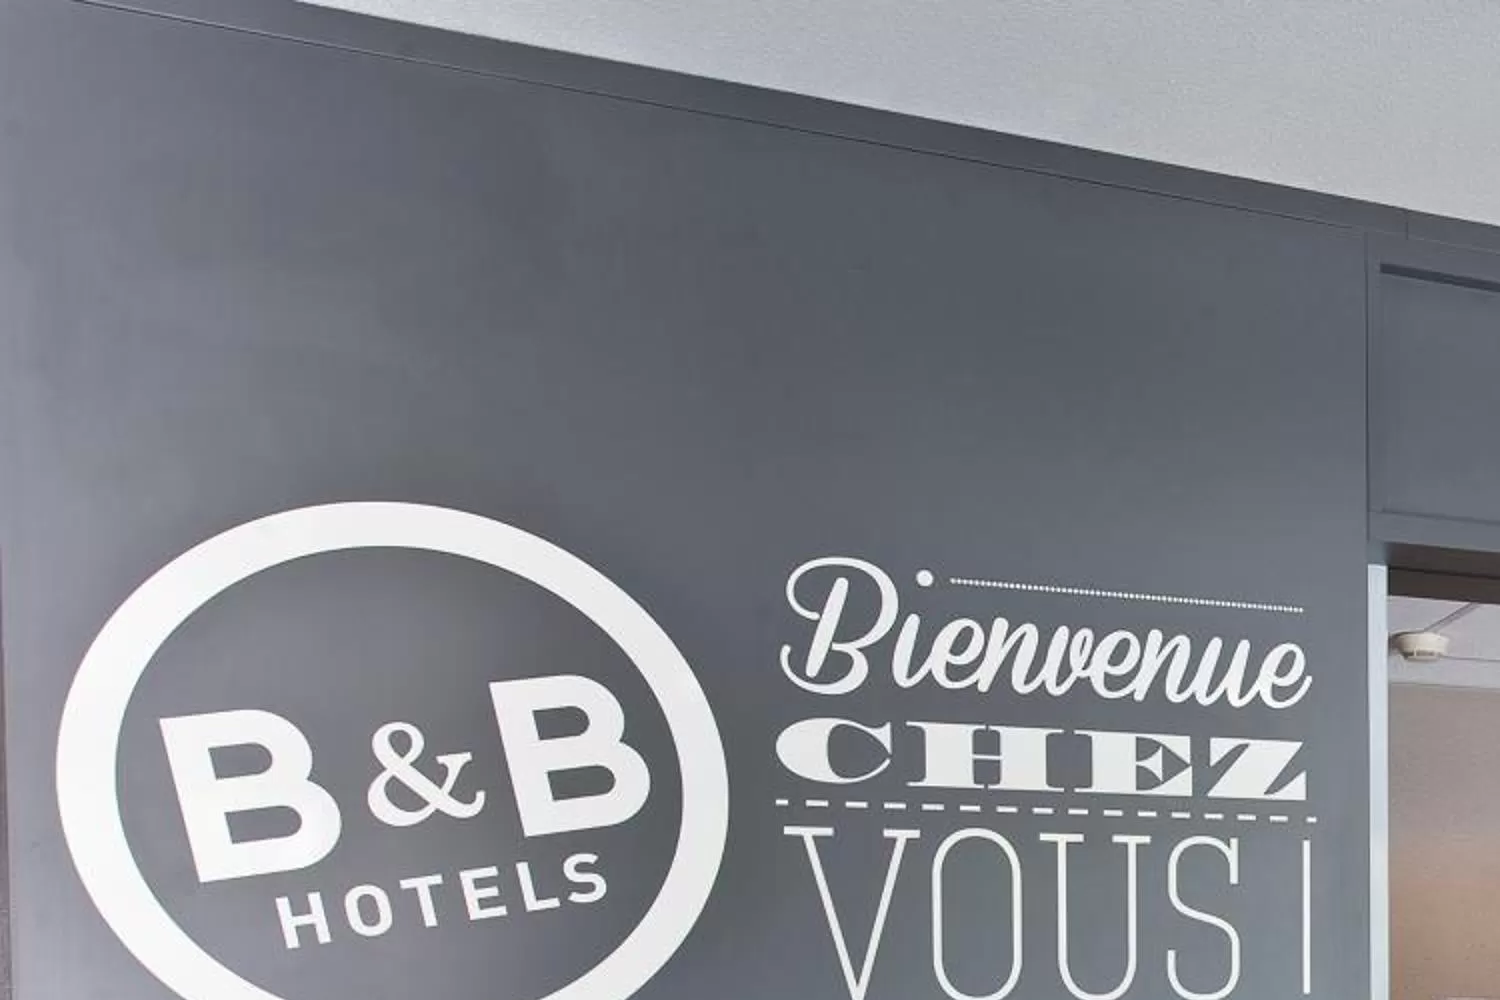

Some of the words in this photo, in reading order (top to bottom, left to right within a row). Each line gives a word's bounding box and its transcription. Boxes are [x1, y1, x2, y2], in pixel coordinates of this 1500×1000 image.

[779, 557, 1313, 709] Bienvenue
[775, 717, 1308, 801] CHEZ
[275, 853, 608, 950] HOTELS
